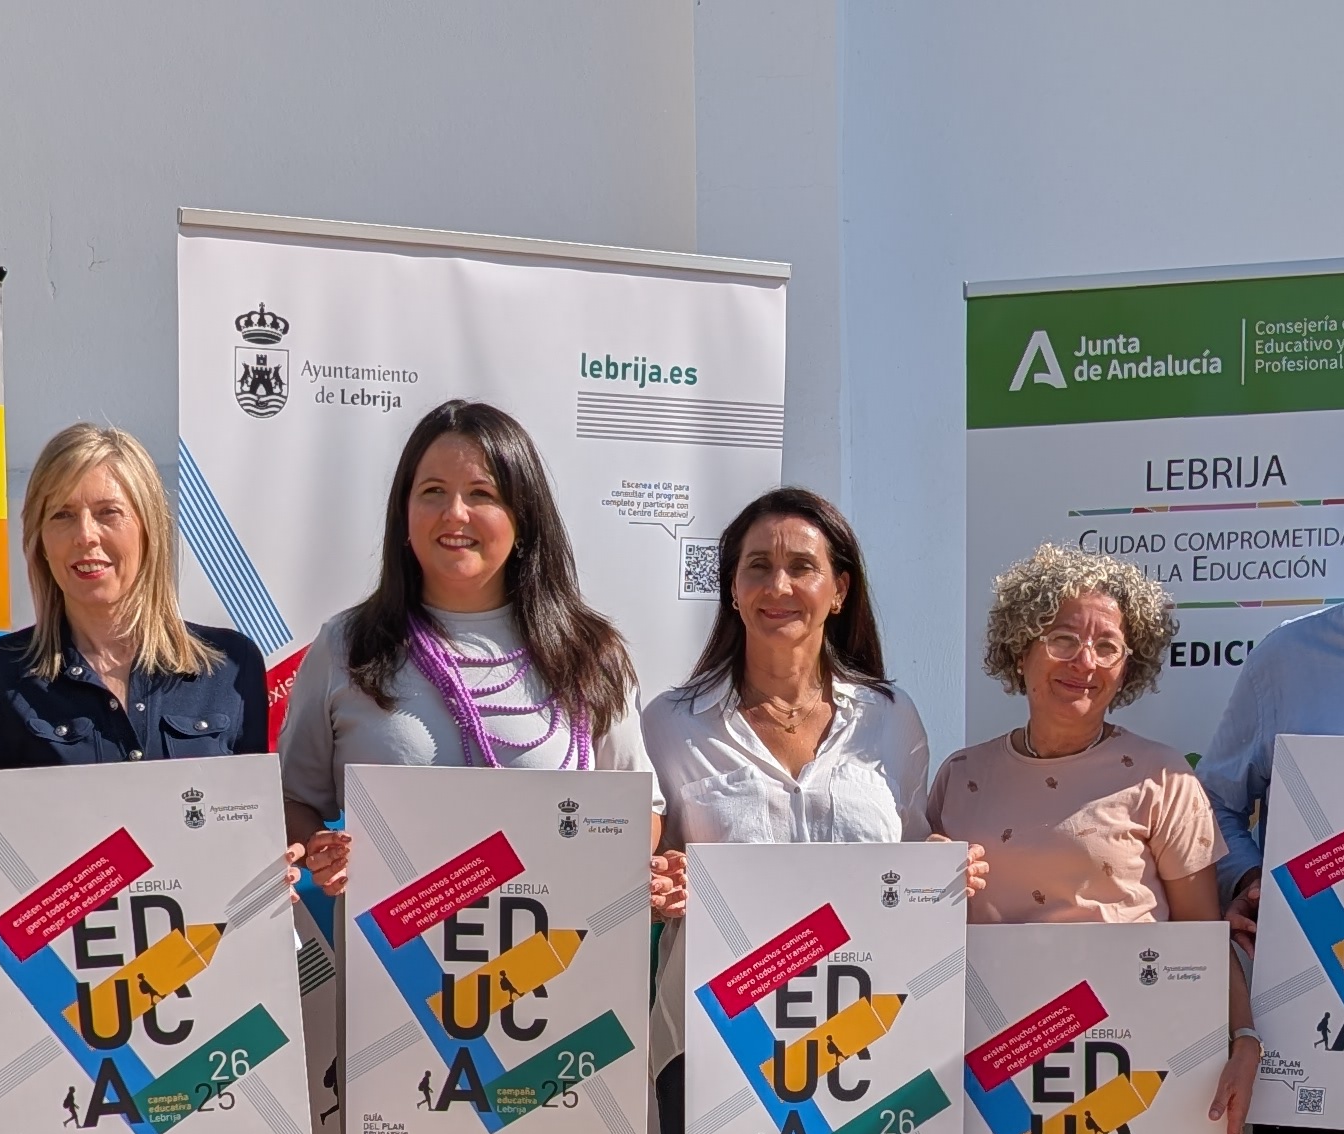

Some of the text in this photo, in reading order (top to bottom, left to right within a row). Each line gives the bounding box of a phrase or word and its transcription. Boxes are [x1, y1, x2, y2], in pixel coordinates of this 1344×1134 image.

[1254, 315, 1338, 337] Consejería
[1073, 333, 1141, 357] Junta
[1254, 333, 1333, 354] Educativo
[301, 359, 419, 386] Ayuntamiento
[580, 352, 699, 388] lebrija.es
[1073, 350, 1223, 382] de Andalucía
[1254, 353, 1344, 374] Profesional
[315, 386, 403, 413] de Lebrija
[1145, 454, 1287, 493] LEBRIJA
[128, 878, 182, 894] LEBRIJA
[499, 883, 550, 896] LEBRIJA
[827, 951, 873, 963] LEBRIJA
[1084, 1028, 1132, 1040] LEBRIJA
[209, 1050, 250, 1082] 26
[434, 1046, 493, 1112] A
[557, 1051, 595, 1080] 26
[83, 1057, 145, 1129] A
[194, 1081, 236, 1113] 25
[541, 1081, 579, 1109] 25
